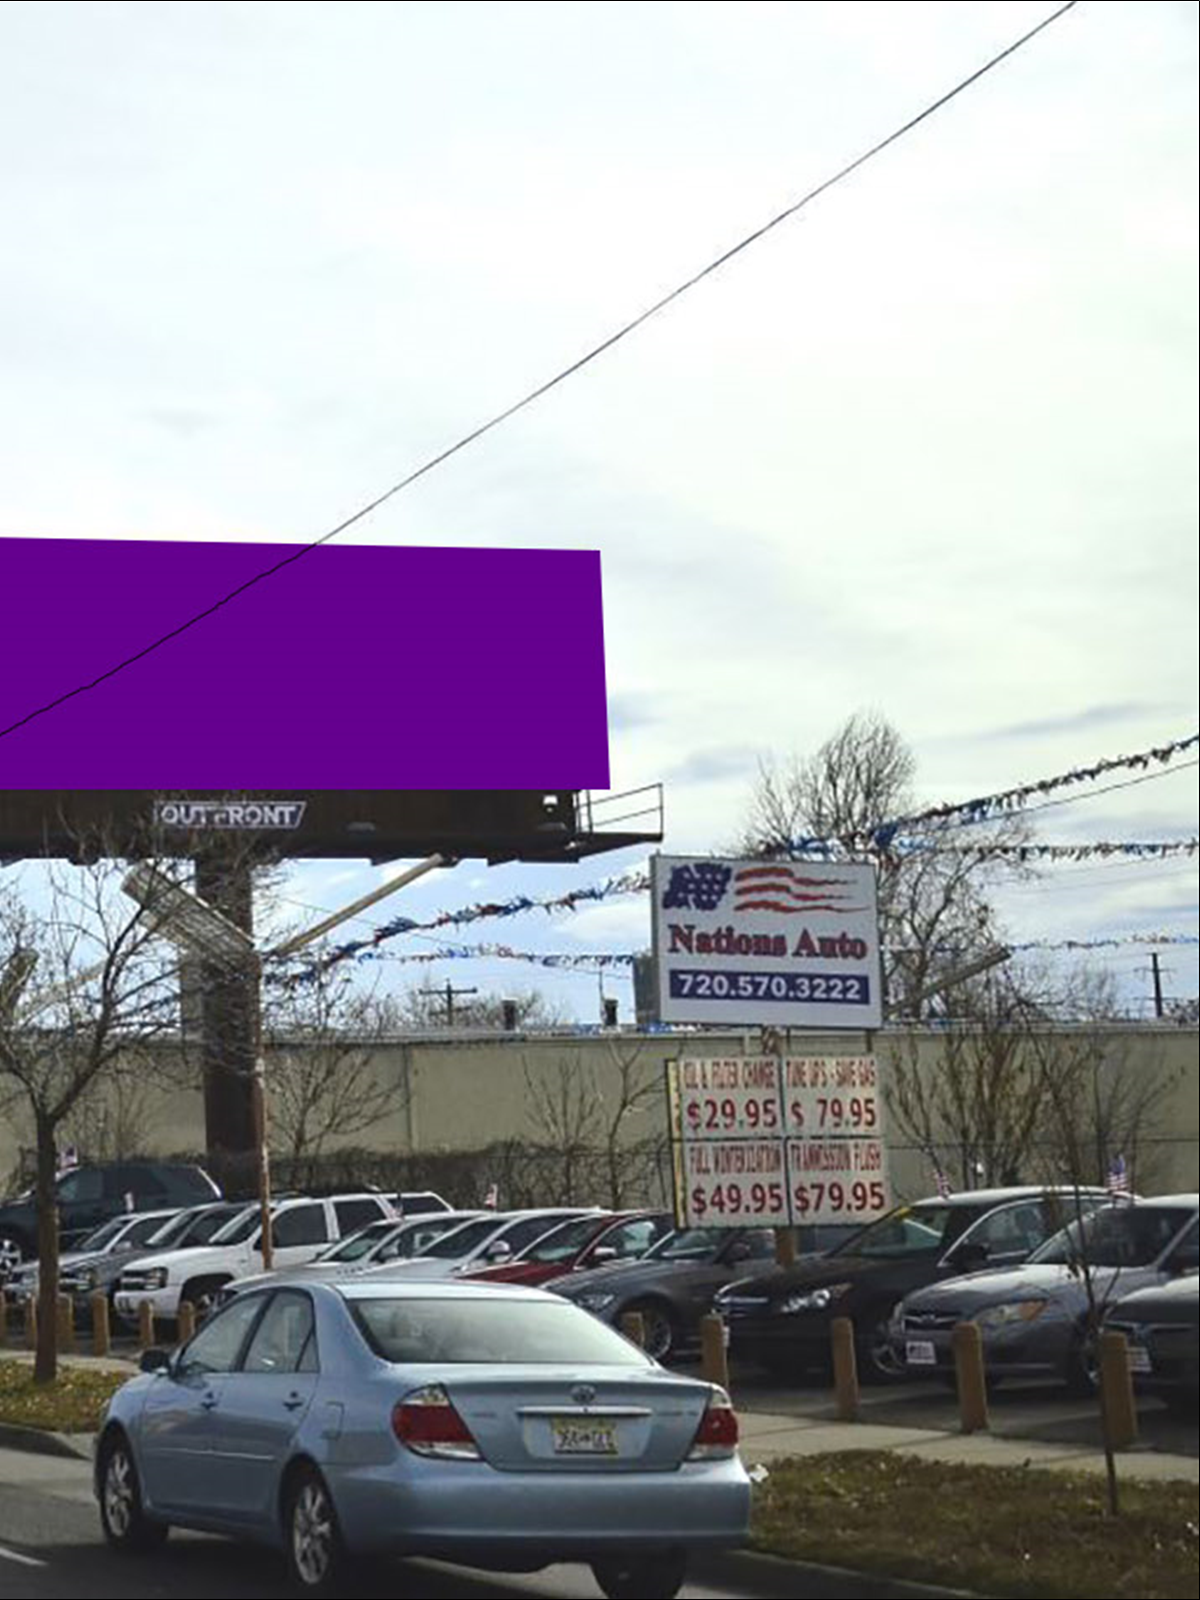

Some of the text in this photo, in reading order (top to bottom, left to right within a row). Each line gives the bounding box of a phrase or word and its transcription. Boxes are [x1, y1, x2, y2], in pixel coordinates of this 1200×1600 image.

[160, 804, 296, 825] OUTFRONT
[667, 924, 868, 960] Nations Auto
[678, 973, 861, 1000] 720.570.3222
[686, 1099, 777, 1133] $29.95
[692, 1184, 783, 1219] $49.95
[794, 1182, 885, 1217] $79.95
